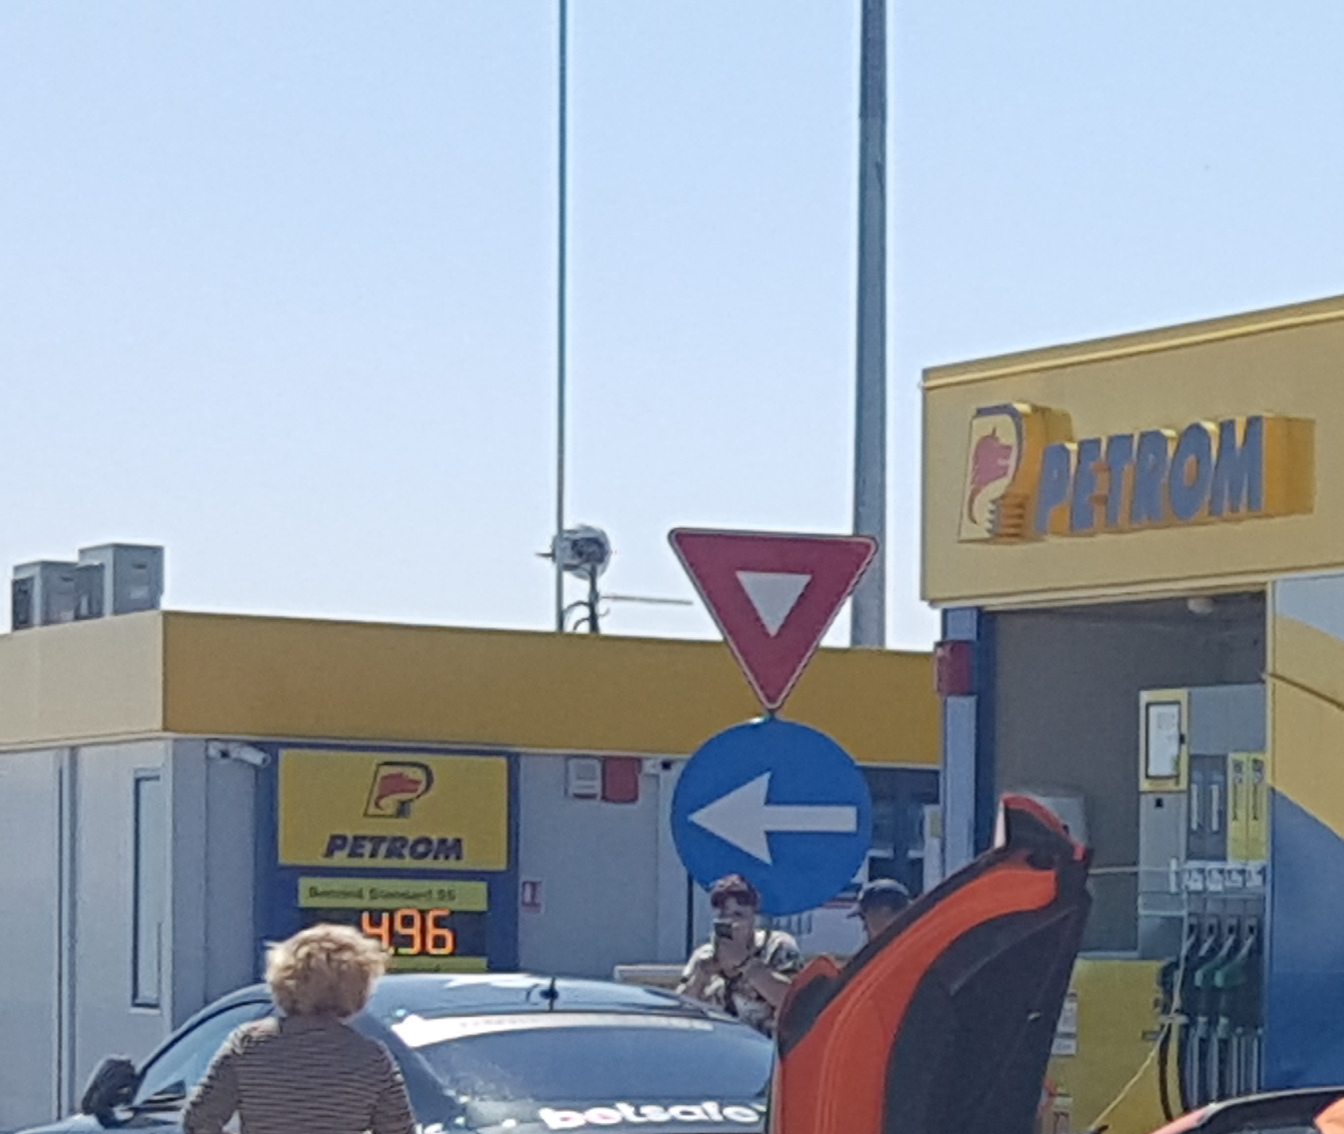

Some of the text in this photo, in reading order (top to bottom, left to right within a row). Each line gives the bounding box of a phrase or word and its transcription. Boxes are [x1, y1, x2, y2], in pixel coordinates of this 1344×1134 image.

[1033, 414, 1266, 536] PETROM
[322, 833, 464, 861] PETROM
[538, 1100, 760, 1130] betsafe
